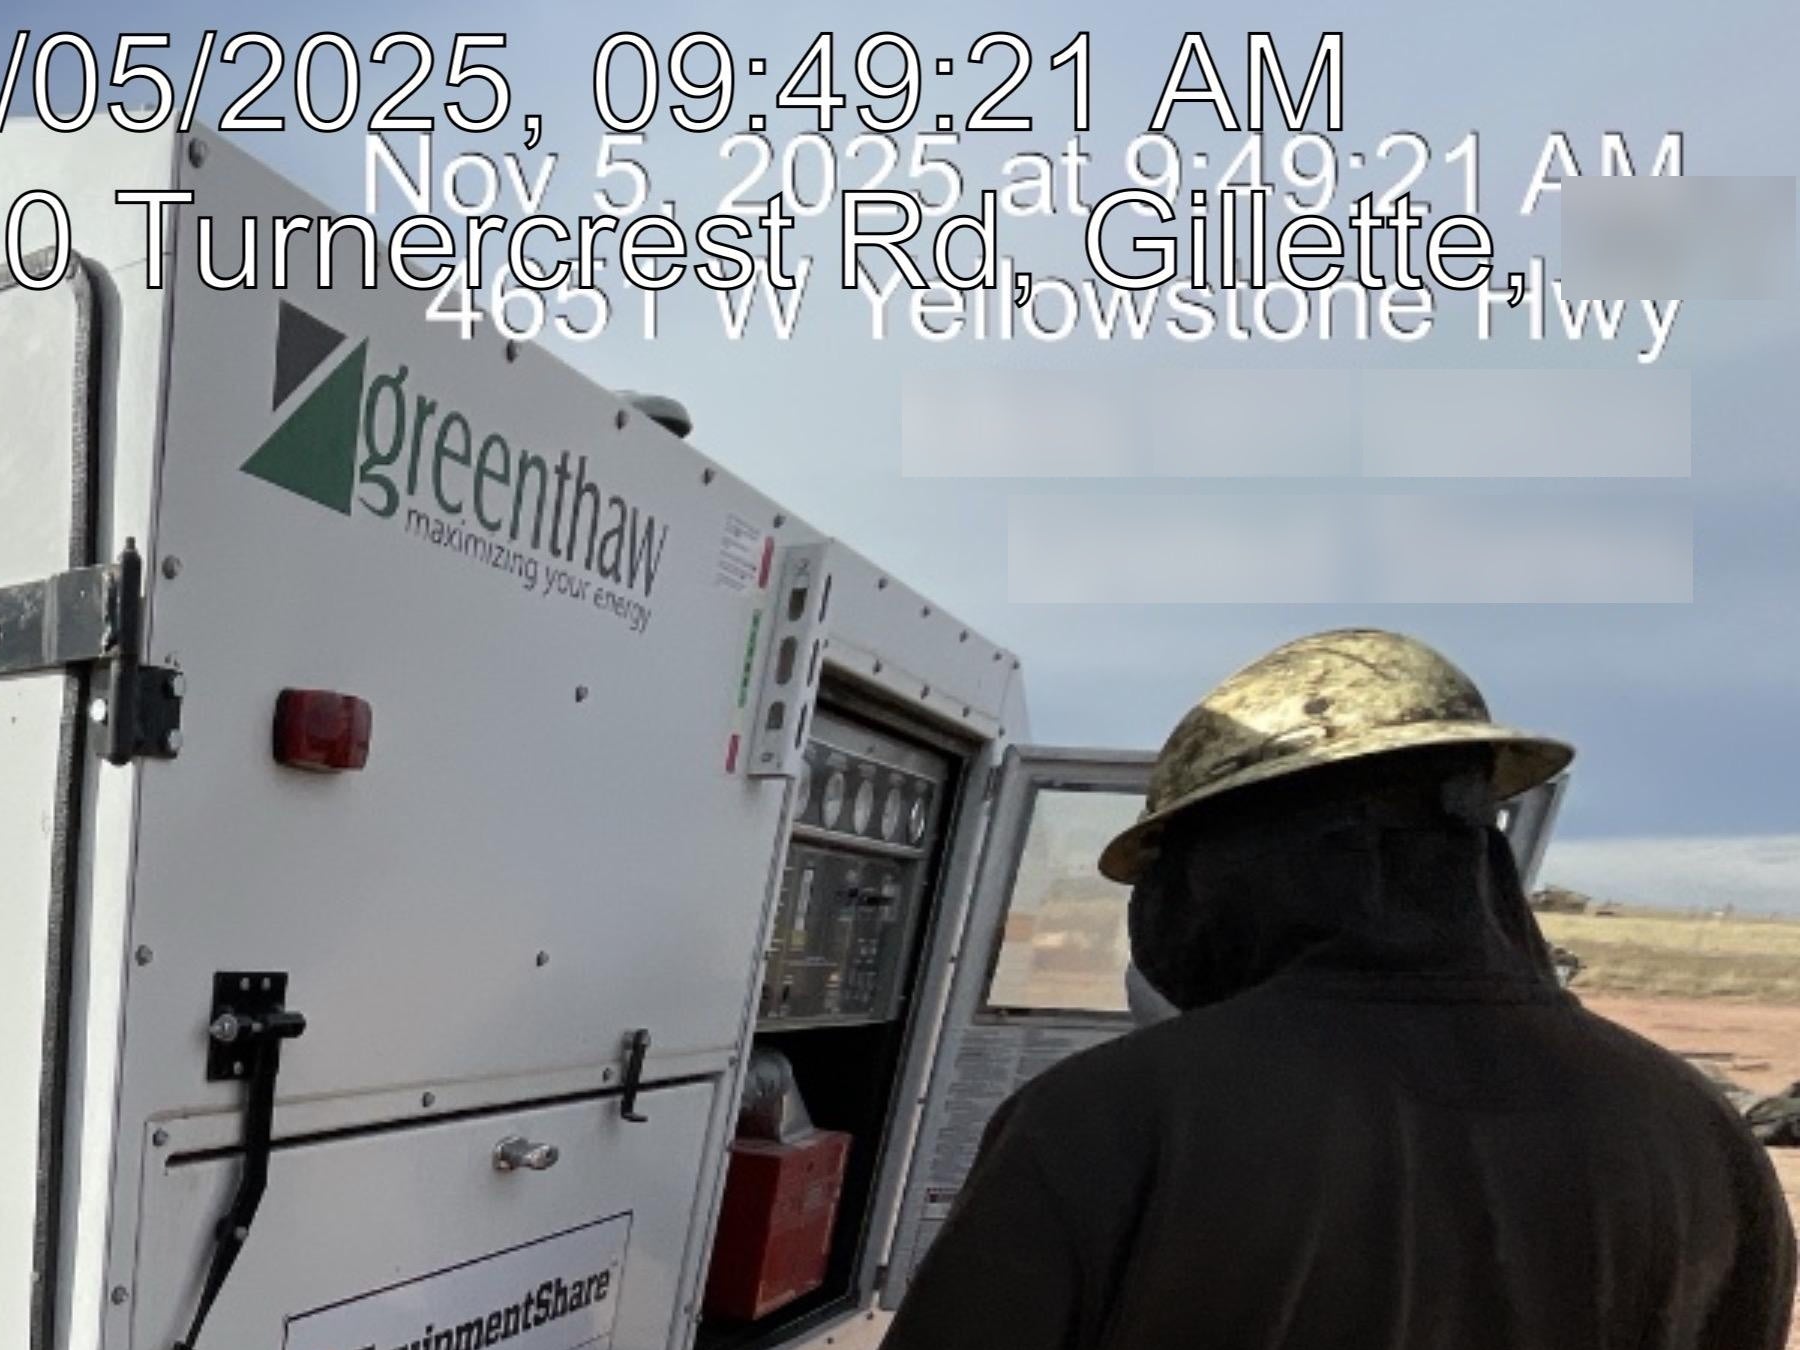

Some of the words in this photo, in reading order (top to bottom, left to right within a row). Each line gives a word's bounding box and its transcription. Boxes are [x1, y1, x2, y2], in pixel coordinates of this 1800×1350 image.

[359, 365, 670, 598] greenthaw
[404, 506, 539, 591] maximizing
[542, 565, 591, 600] your
[593, 587, 651, 634] energy
